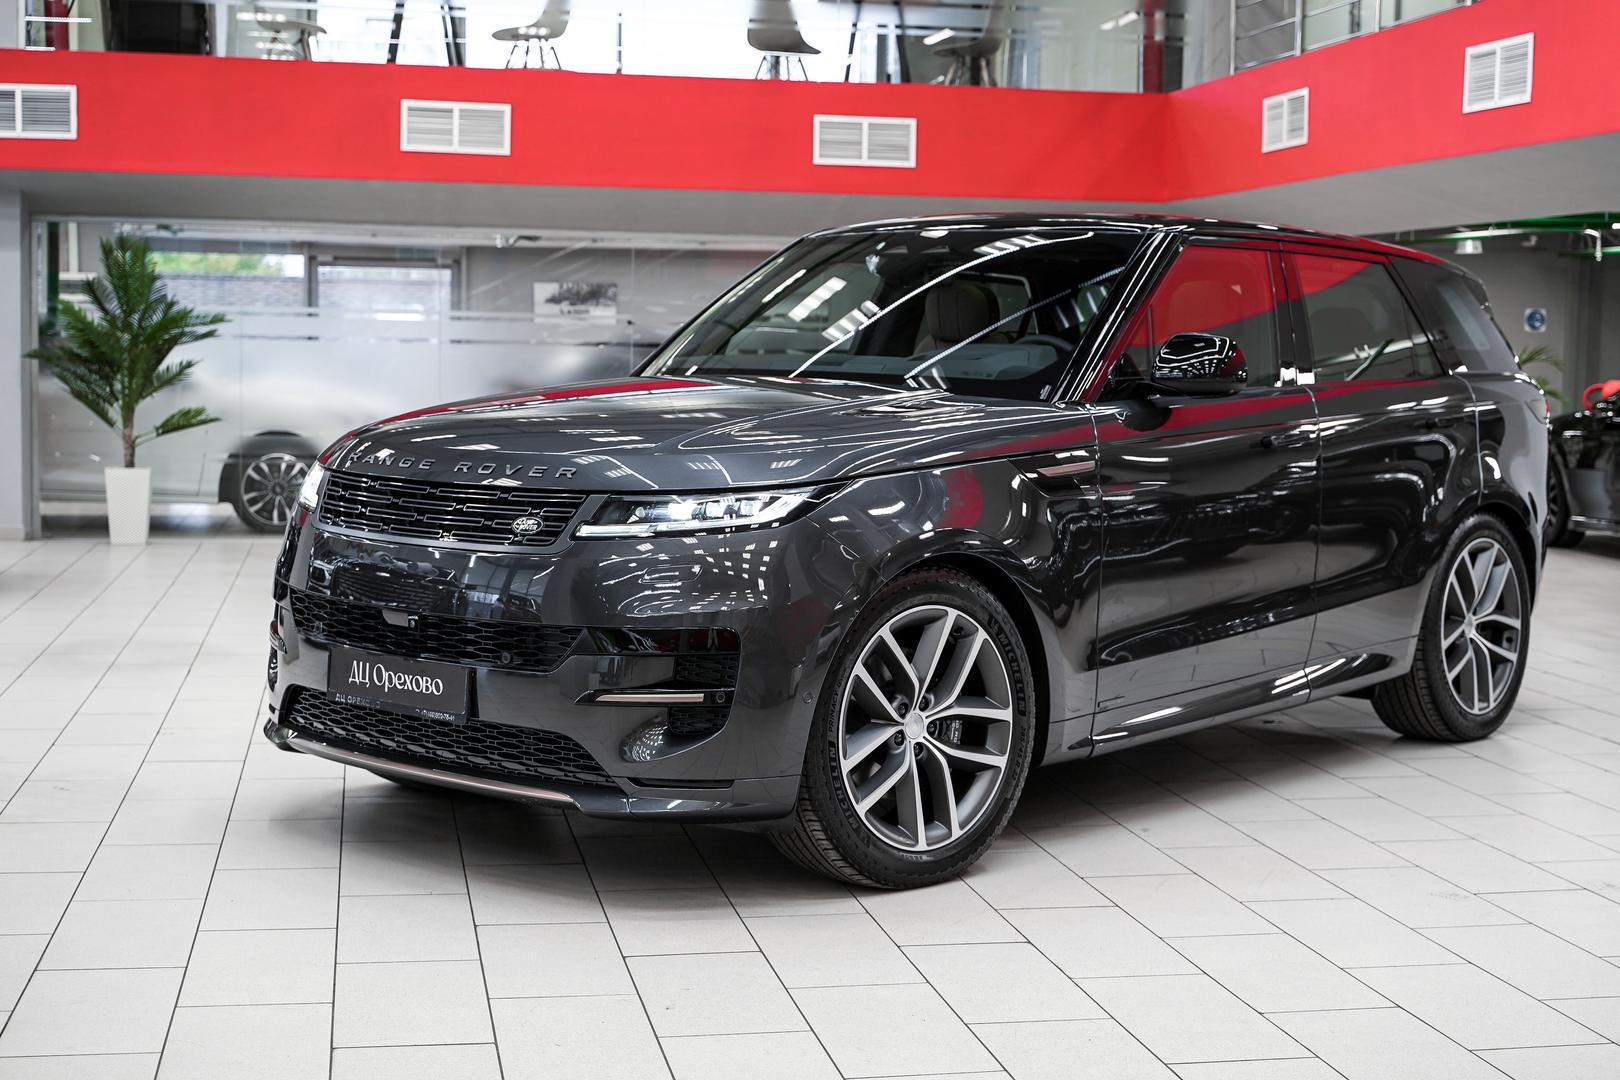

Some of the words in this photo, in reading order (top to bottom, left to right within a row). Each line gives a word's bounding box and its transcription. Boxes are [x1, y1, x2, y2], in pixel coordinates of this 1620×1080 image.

[348, 451, 436, 469] RANGE
[454, 462, 578, 479] ROVER
[349, 660, 370, 688] ДЦ
[373, 663, 443, 695] Орехово
[998, 633, 1026, 711] MICHELIN
[827, 690, 839, 733] PRIMACY
[829, 746, 860, 830] MICHELIN
